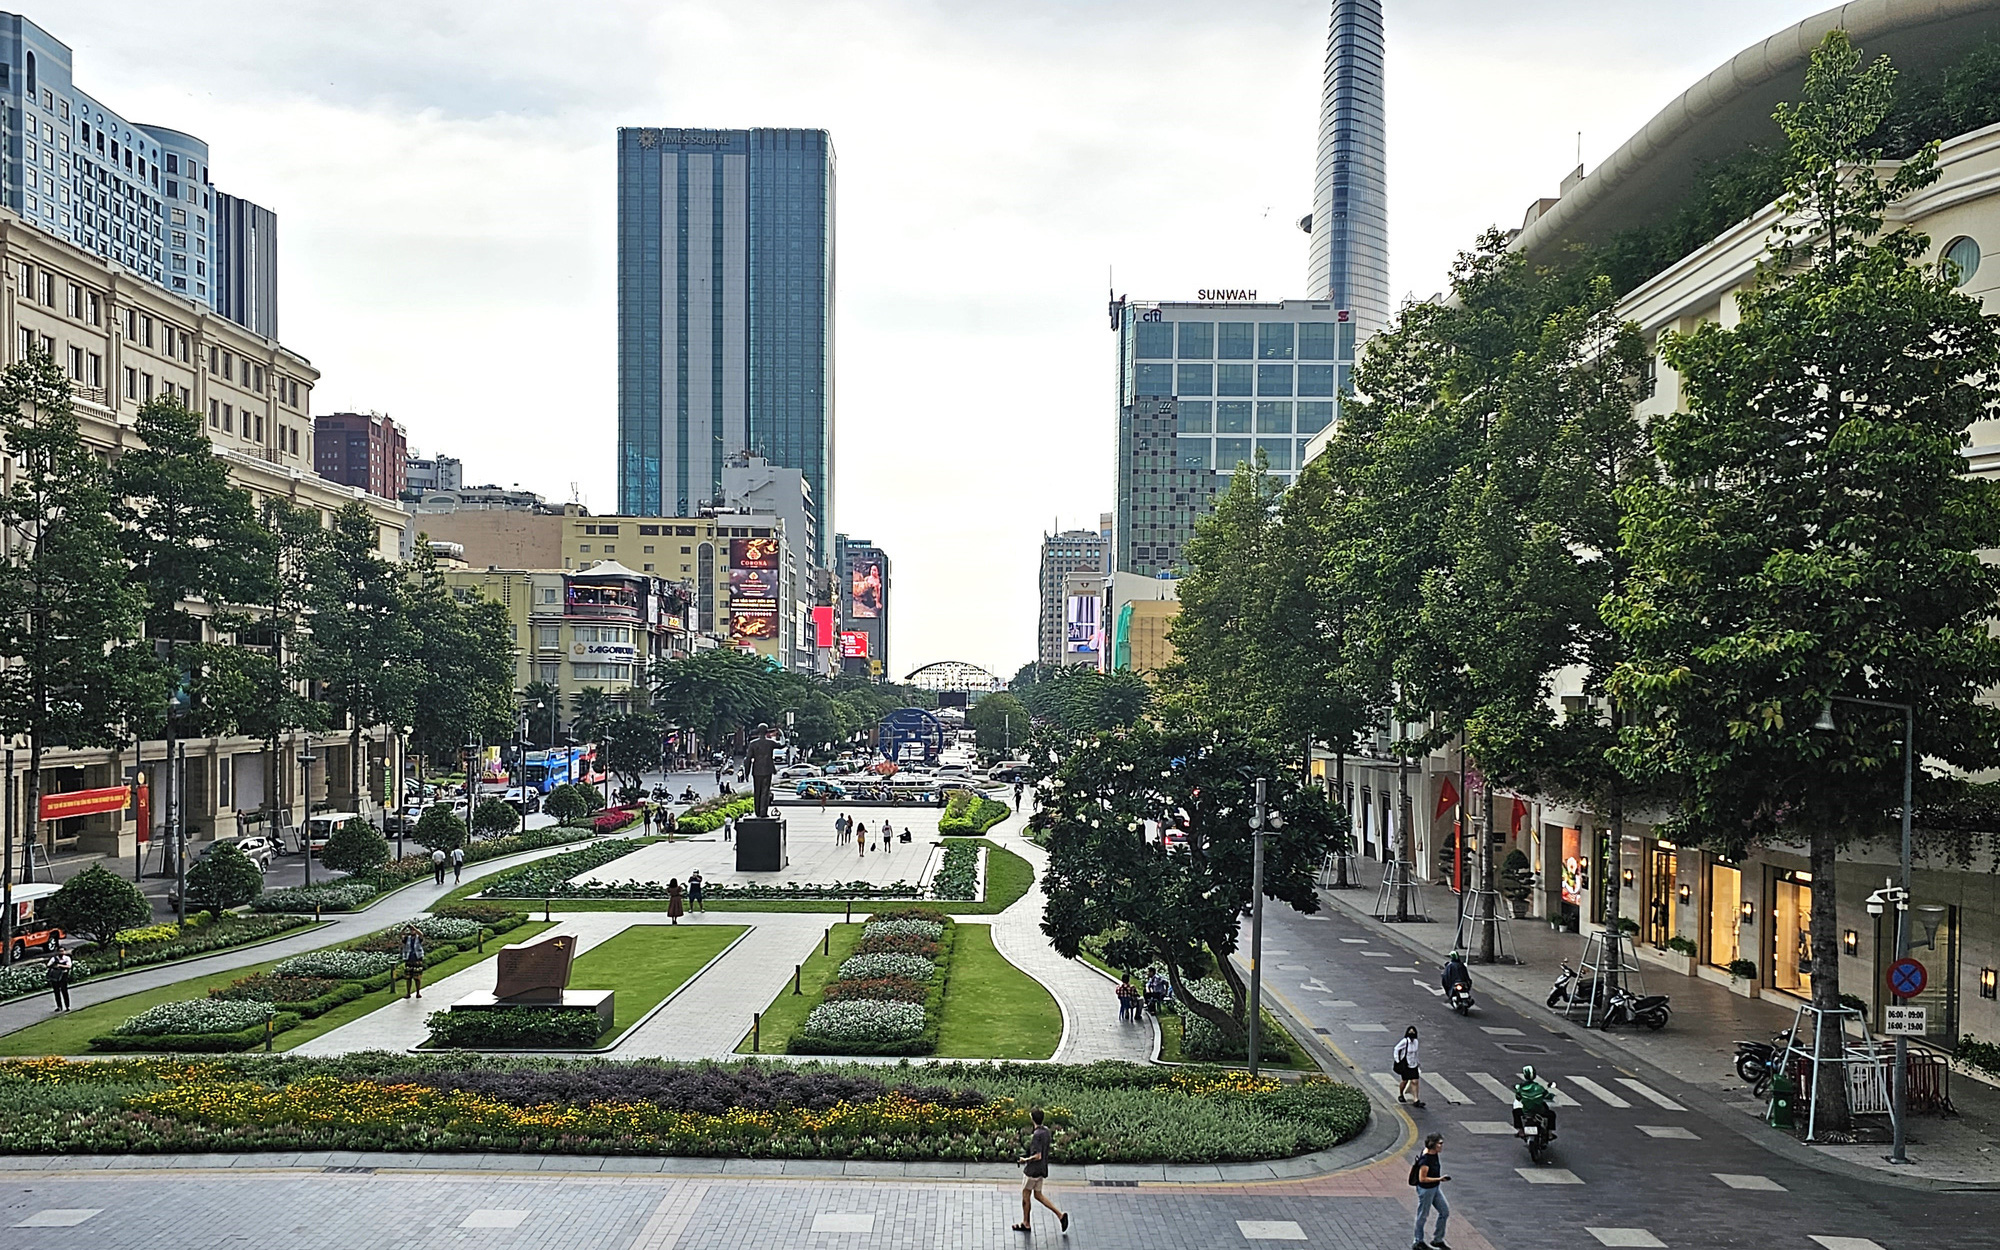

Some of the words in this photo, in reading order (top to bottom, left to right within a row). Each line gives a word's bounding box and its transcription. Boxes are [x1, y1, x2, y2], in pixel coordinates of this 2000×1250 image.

[661, 136, 688, 144] TIMES
[691, 136, 730, 146] SQUARE
[1198, 289, 1257, 300] SUNWAH
[1143, 309, 1162, 322] citi
